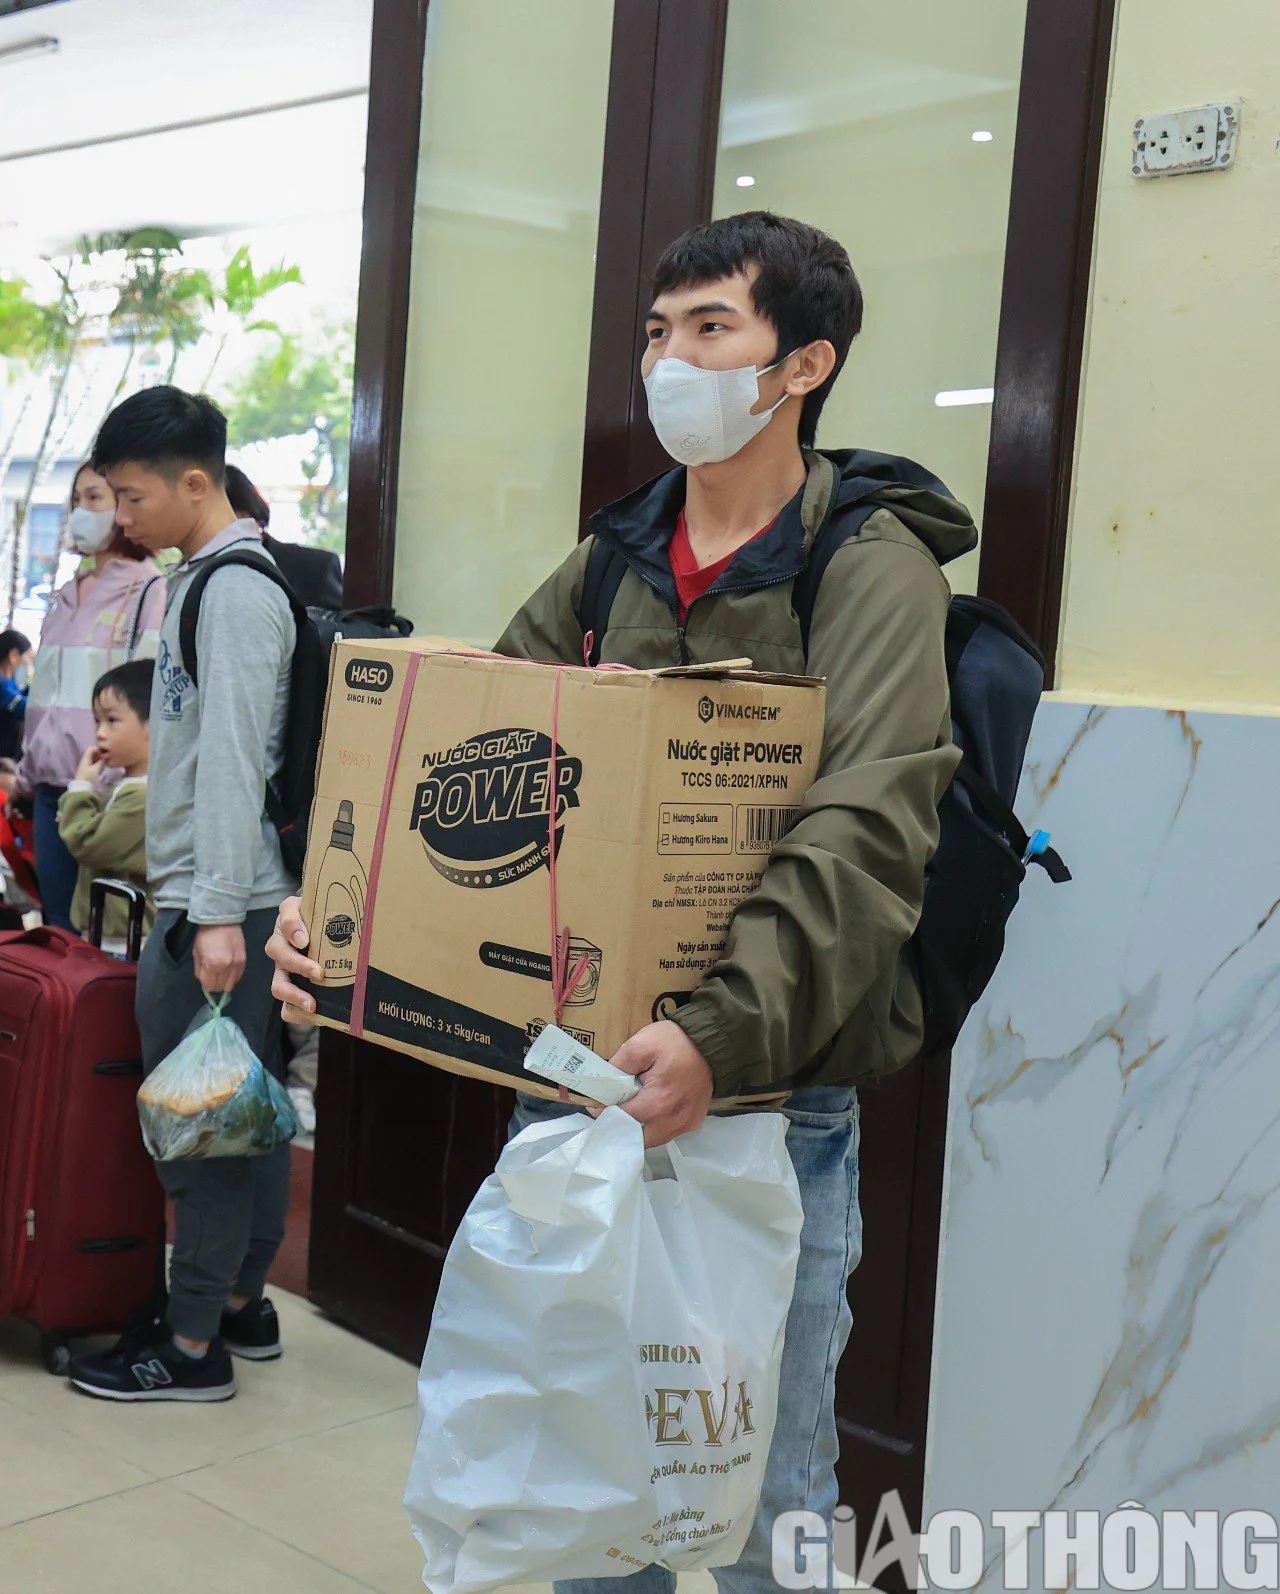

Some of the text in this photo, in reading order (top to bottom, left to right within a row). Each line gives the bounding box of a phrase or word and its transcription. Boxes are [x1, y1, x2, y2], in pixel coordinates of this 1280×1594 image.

[350, 665, 388, 686] HASO
[346, 693, 383, 706] SINCE 1960
[421, 732, 537, 769] NƯỚC GIẶT
[668, 739, 803, 766] Nước giặt POWER
[681, 772, 788, 789] TCCS 06:2021/XPHN
[409, 756, 583, 831] POWER
[673, 813, 718, 825] Hương Sakura
[672, 834, 729, 846] Hương Kiiro Hana
[706, 871, 725, 882] CÔNG
[726, 872, 734, 881] TY
[325, 921, 356, 935] POWER
[677, 942, 697, 954] Ngày
[697, 941, 709, 951] sản
[324, 958, 353, 971] KLT: 5 kg
[528, 962, 551, 972] NGANG
[659, 958, 675, 971] Hạn
[378, 999, 399, 1019] KHỐI
[437, 1018, 444, 1032] 3
[446, 1023, 452, 1033] x
[454, 1023, 491, 1046] 5kg/can
[645, 1376, 756, 1448] EVA
